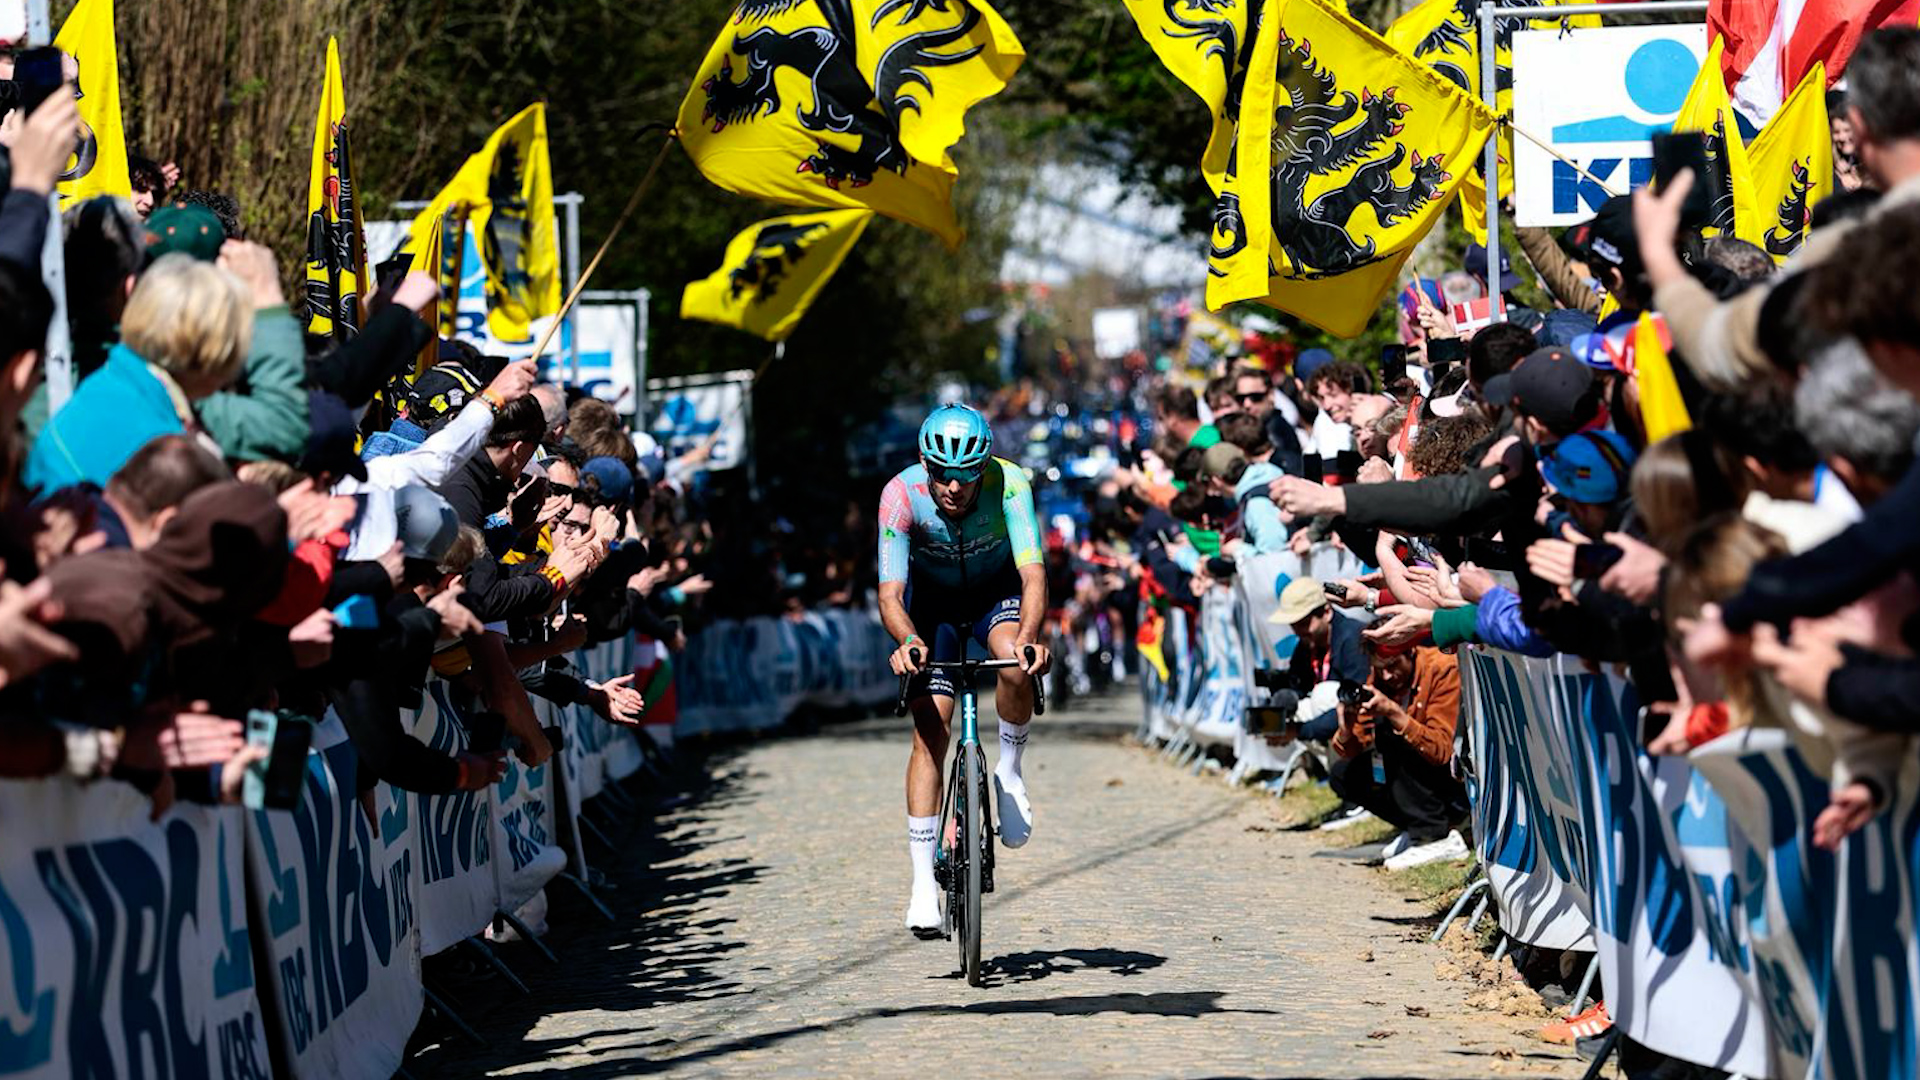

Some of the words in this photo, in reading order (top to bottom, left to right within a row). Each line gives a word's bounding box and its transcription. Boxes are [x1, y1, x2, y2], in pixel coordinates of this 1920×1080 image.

[35, 818, 211, 1080] KBC
[1738, 748, 1920, 1080] KB
[217, 1011, 272, 1080] KBC
